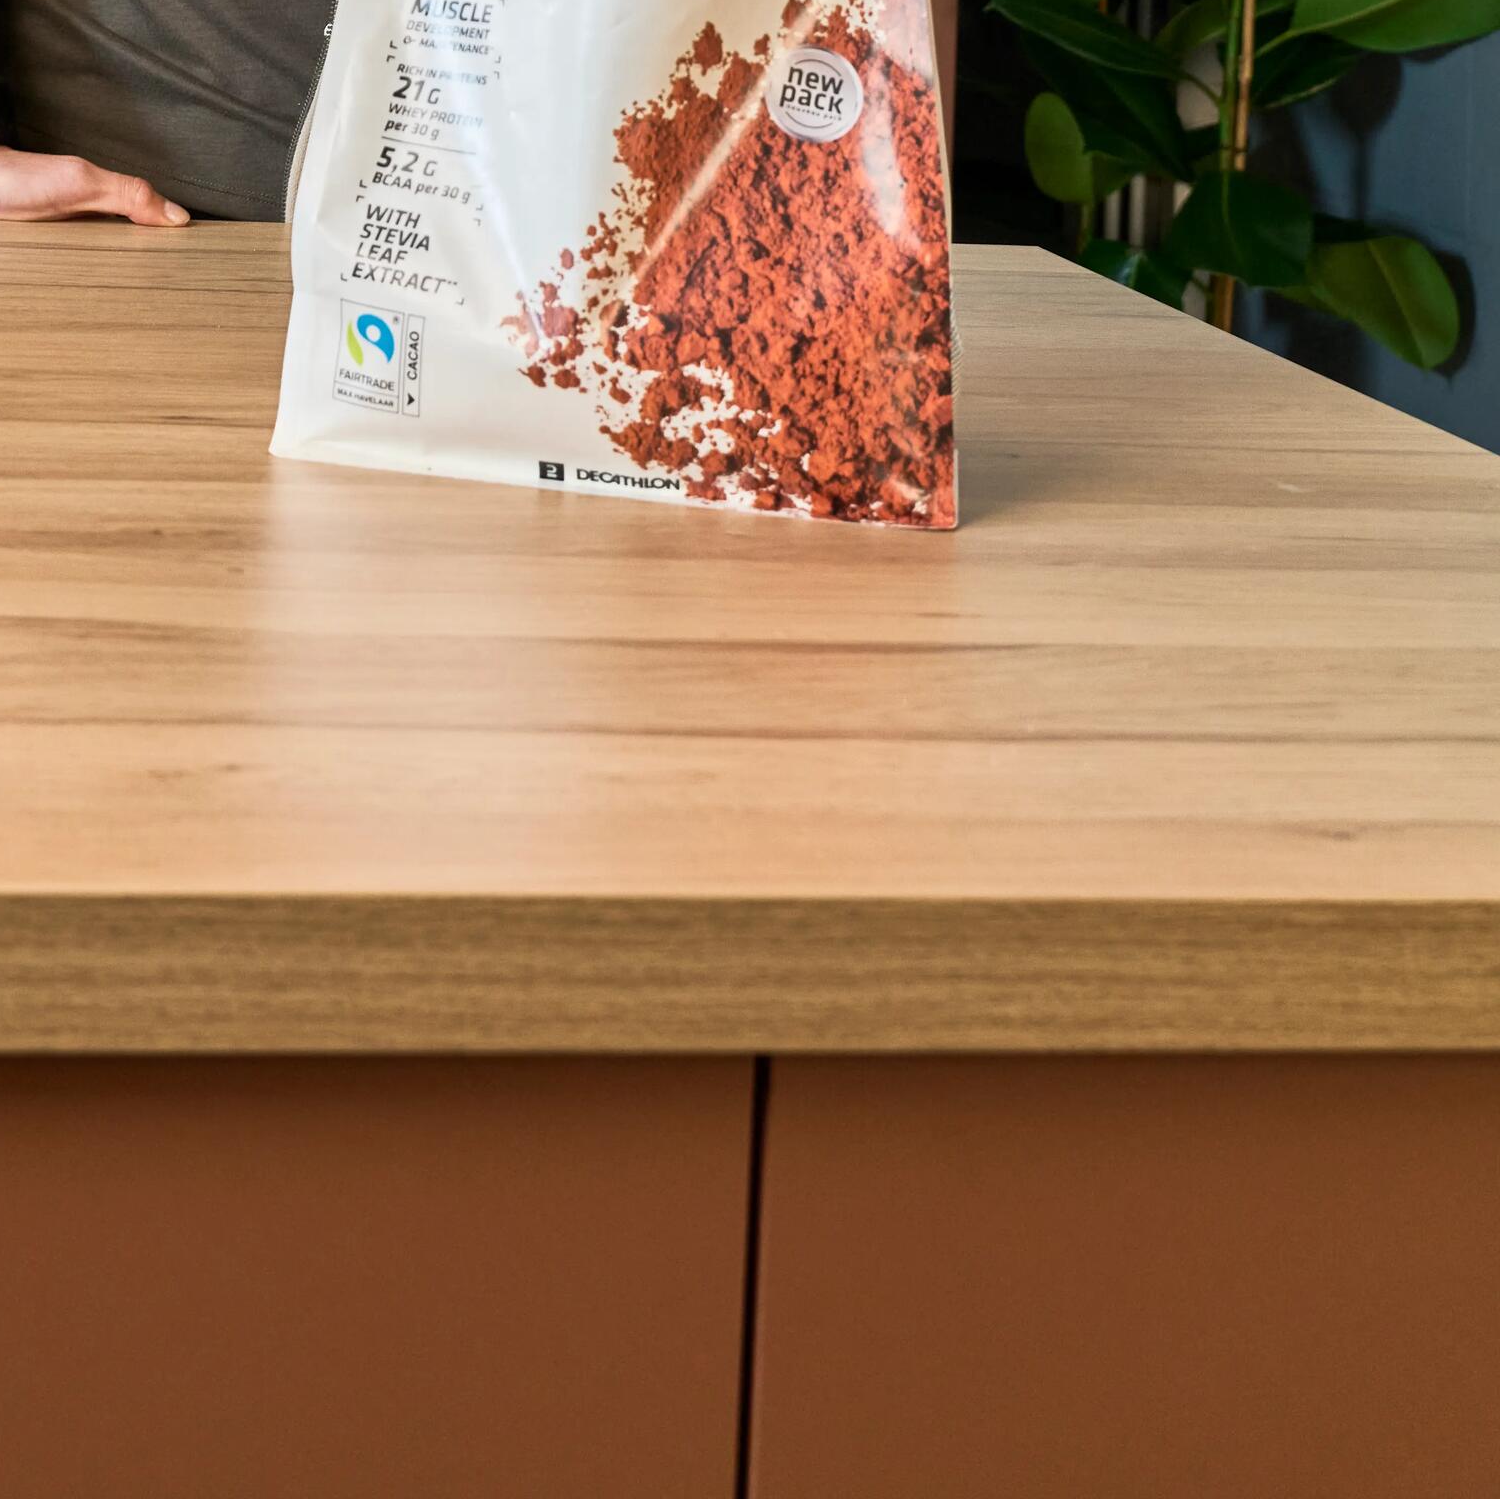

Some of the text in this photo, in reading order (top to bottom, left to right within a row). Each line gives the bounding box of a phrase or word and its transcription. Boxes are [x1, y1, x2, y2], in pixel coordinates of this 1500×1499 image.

[396, 63, 424, 76] RICH
[425, 68, 438, 79] IN
[788, 66, 843, 95] new
[392, 76, 441, 104] 21 G
[779, 84, 843, 114] pack
[388, 102, 483, 128] WHEY PROTEIN
[384, 120, 441, 141] per 30 g
[376, 146, 438, 177] 5,2 G
[372, 171, 471, 204] BCAA per 30 g
[366, 203, 421, 229] WITH
[359, 223, 430, 251] STEVIA
[355, 242, 408, 264] LEAF
[406, 331, 420, 381] CACAO
[338, 368, 395, 392] FAIRTRADE
[576, 468, 681, 490] DECATHLON
